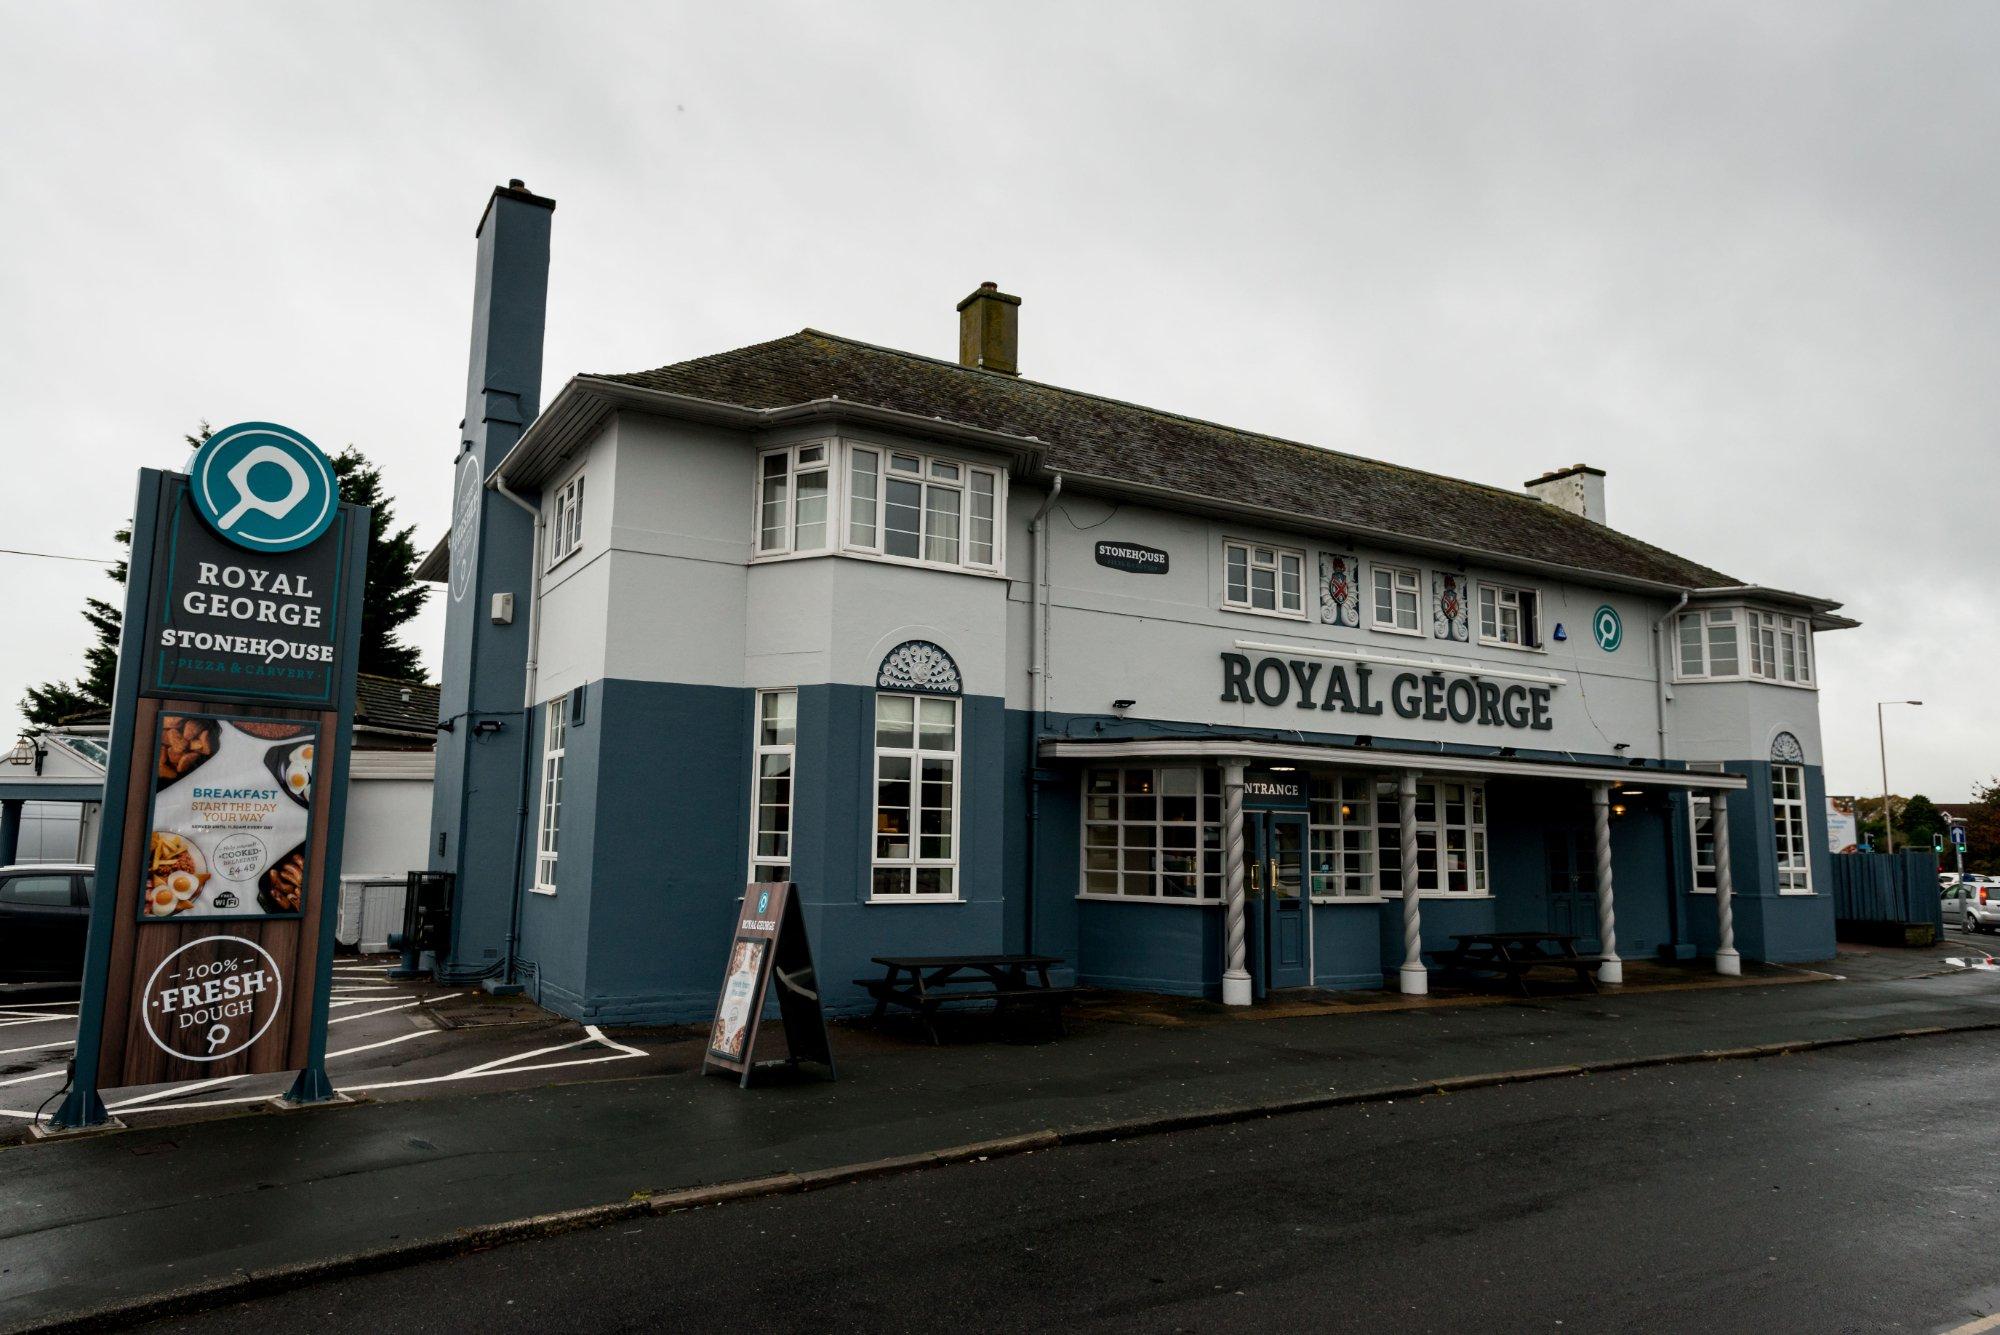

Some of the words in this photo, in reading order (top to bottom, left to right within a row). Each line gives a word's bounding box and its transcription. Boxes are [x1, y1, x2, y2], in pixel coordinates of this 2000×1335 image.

[1099, 545, 1165, 563] STONEHOUSE
[197, 561, 313, 598] ROYAL
[183, 591, 321, 628] GEORGE
[160, 629, 334, 664] STONEHOUSE
[178, 658, 226, 672] PIZZA
[230, 662, 241, 674] &
[245, 664, 316, 680] CARVERY
[1220, 652, 1384, 716] ROYAL
[1391, 672, 1553, 731] GEORGE
[193, 787, 279, 800] BREAKFAST
[1243, 782, 1299, 796] NTRANCE
[191, 801, 228, 812] START
[230, 802, 252, 812] THE
[254, 803, 278, 813] DAY
[203, 812, 237, 822] YOUR
[239, 813, 266, 823] WAY
[221, 847, 259, 860] COOKED
[185, 957, 238, 981] 100%
[160, 969, 267, 1014] FRESH
[179, 999, 254, 1029] DOUGH
